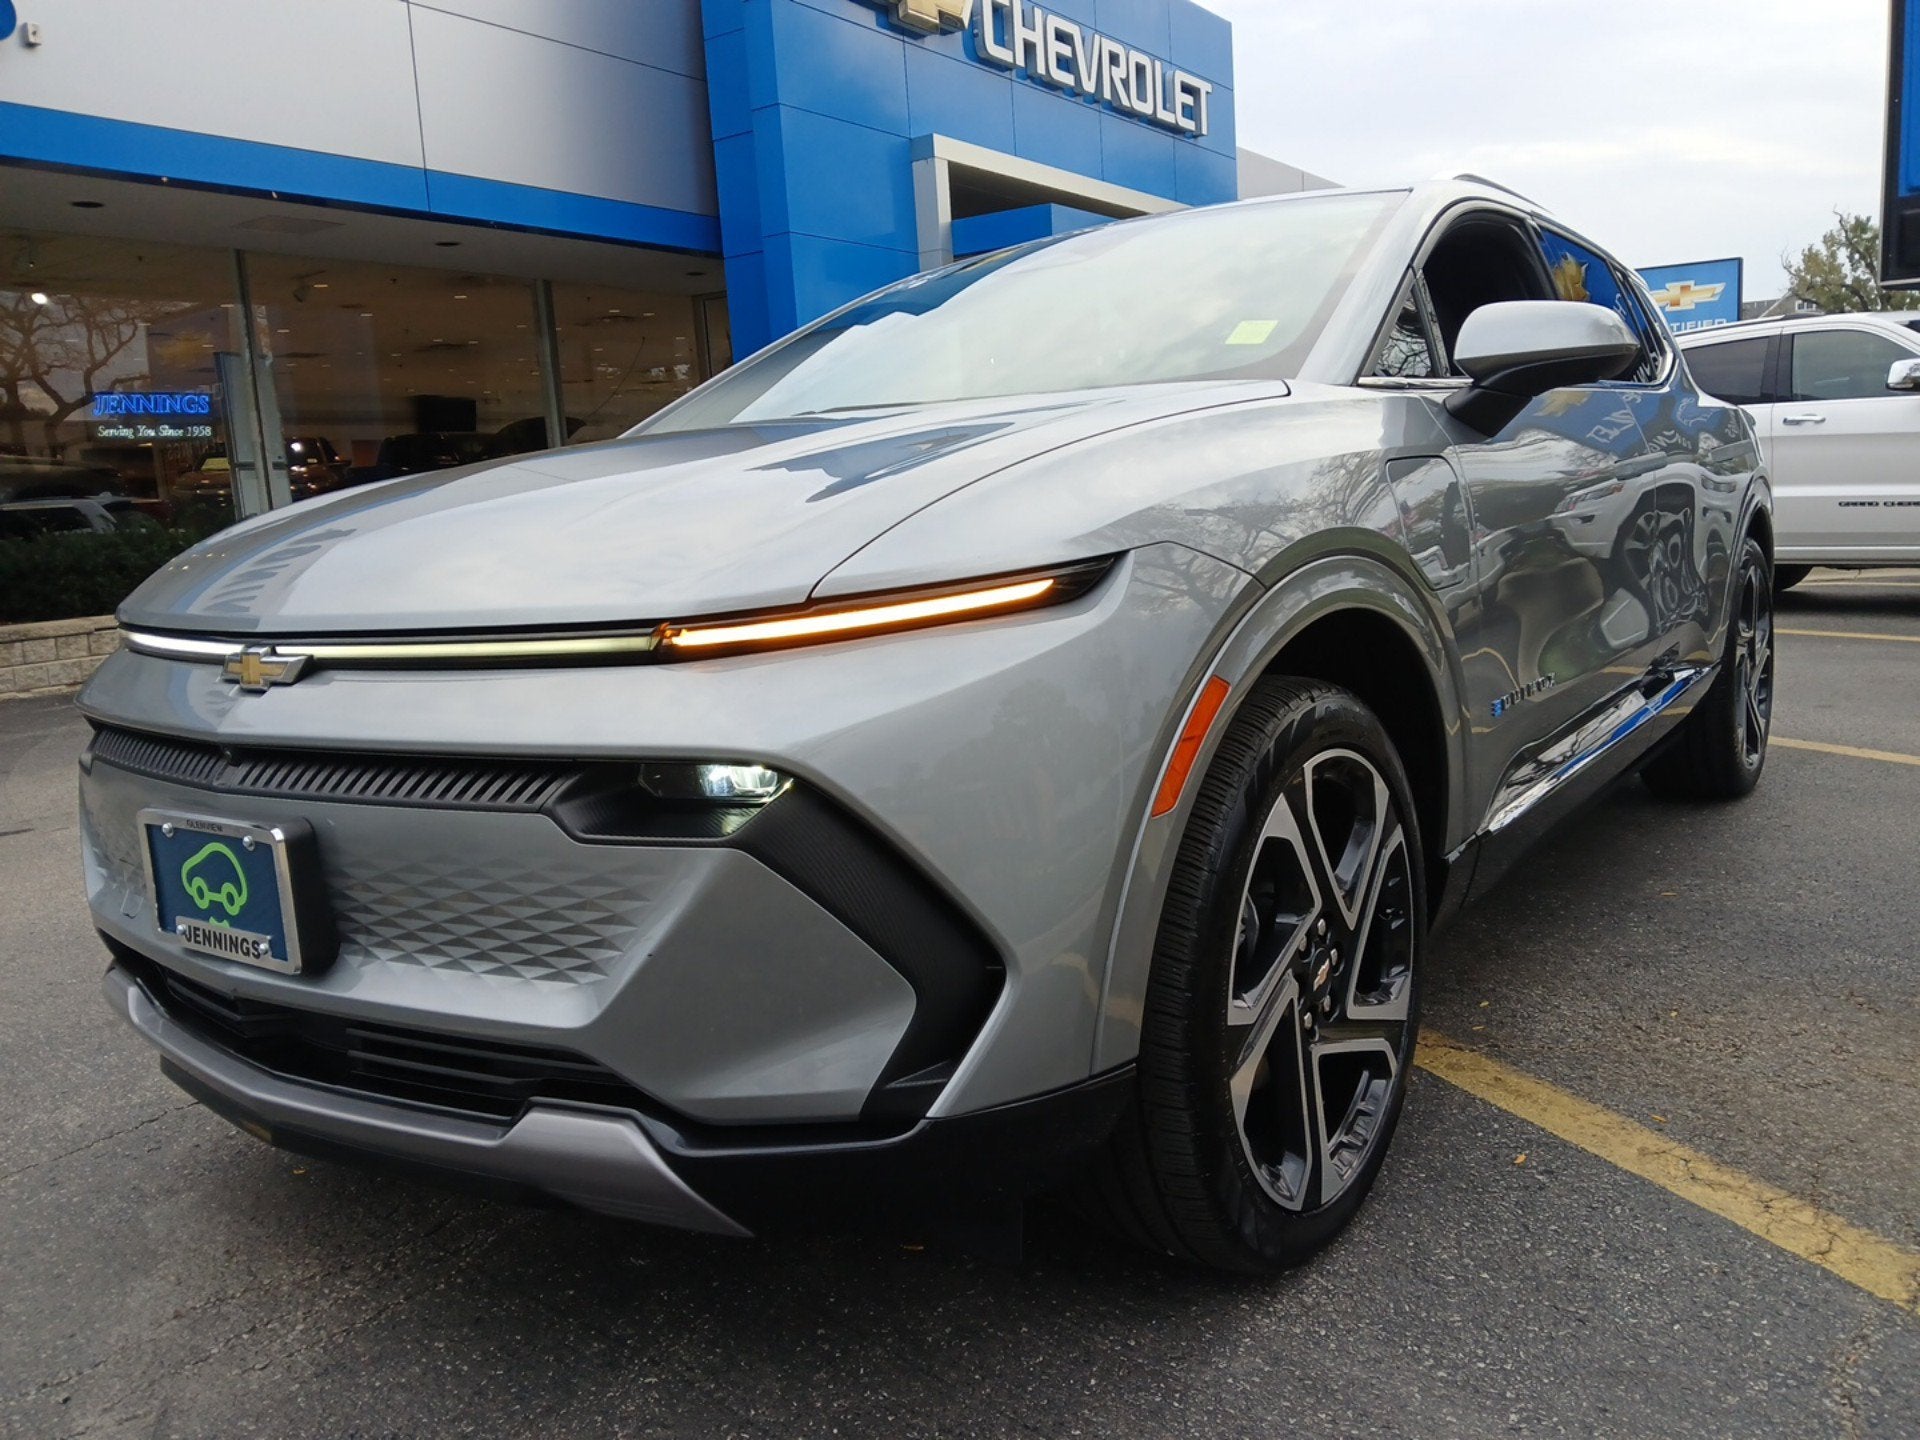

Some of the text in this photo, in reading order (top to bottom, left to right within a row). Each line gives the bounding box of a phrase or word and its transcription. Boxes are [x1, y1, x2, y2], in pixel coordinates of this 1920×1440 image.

[981, 0, 1213, 137] CHEVROLET
[1670, 318, 1727, 333] TIFIED
[93, 393, 210, 416] JENNINGS
[97, 424, 212, 439] Serving You Since 1958
[1491, 672, 1557, 717] EQUINOX
[184, 925, 262, 960] JENNINGS
